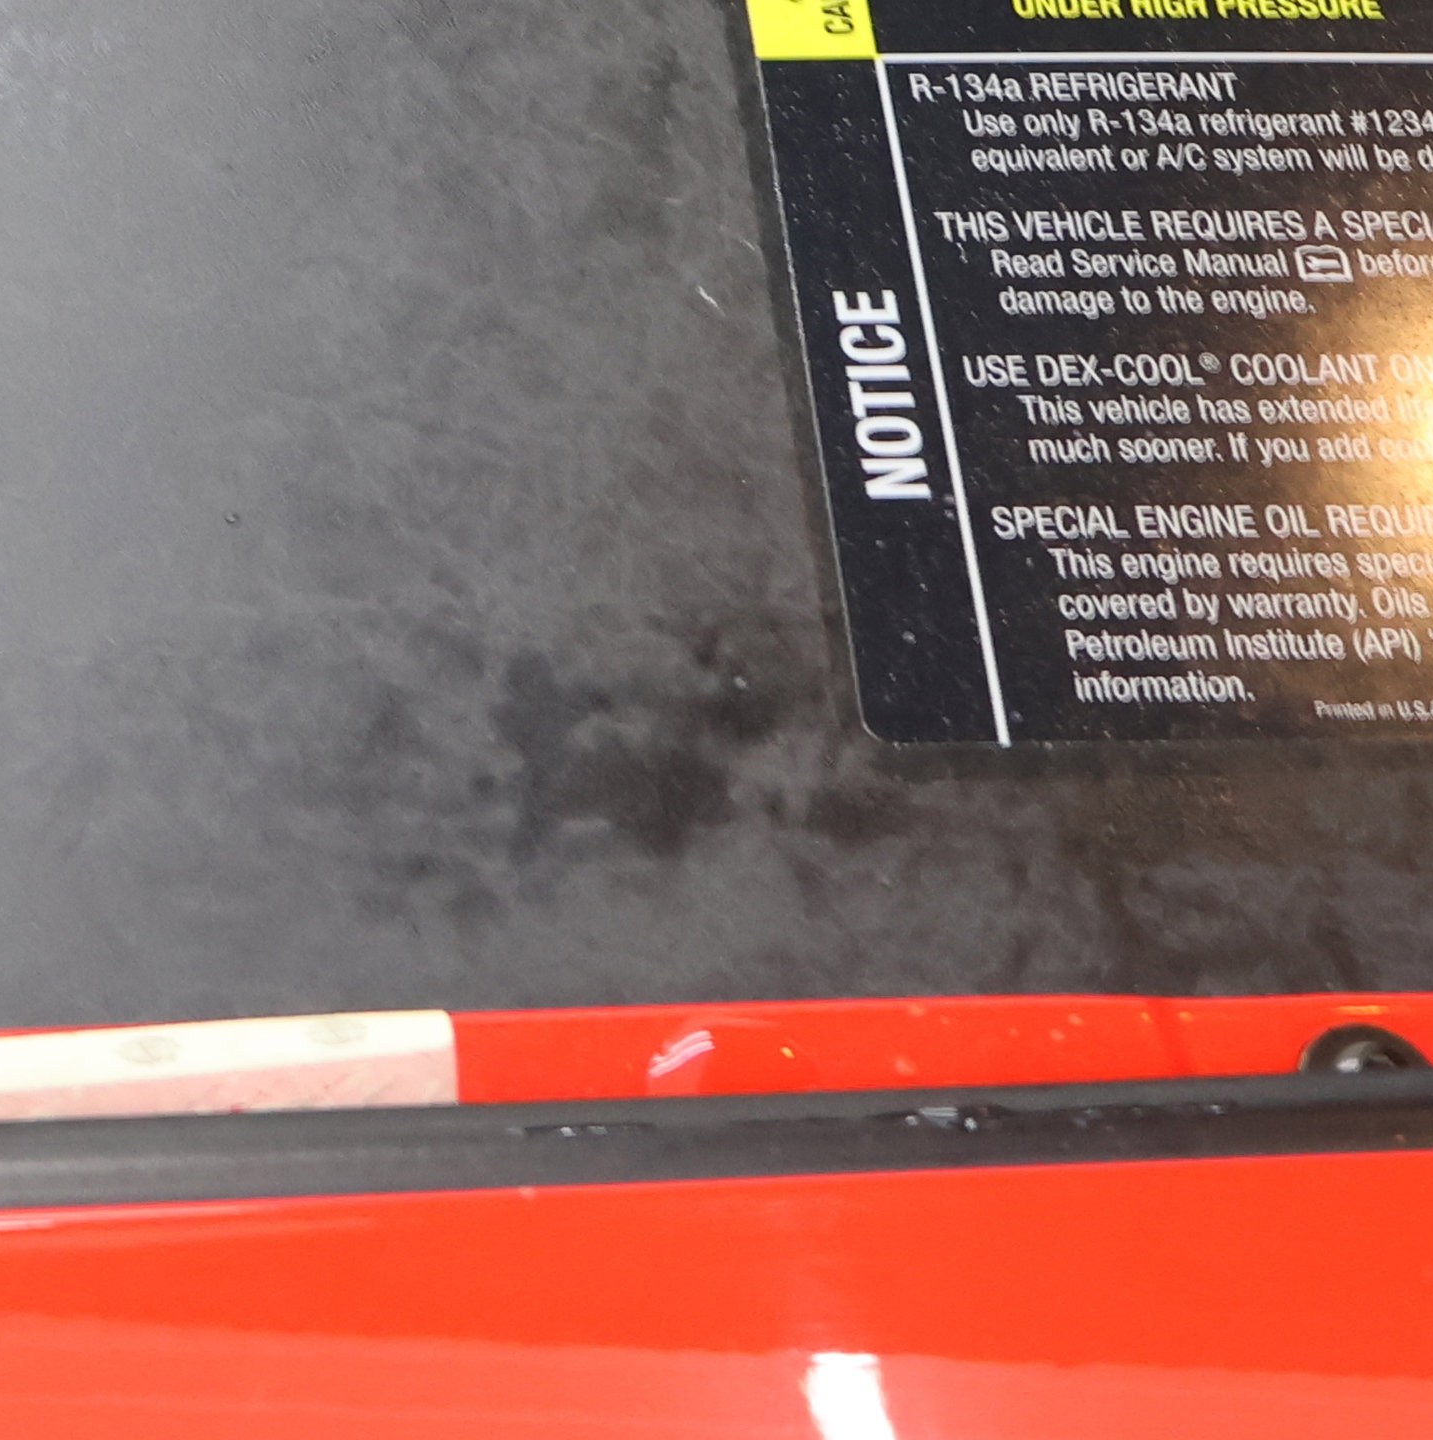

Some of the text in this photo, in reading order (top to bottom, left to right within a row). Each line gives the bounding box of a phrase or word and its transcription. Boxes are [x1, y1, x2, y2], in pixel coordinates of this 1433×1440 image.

[908, 71, 1237, 102] R-134a REFRIGERANT
[962, 108, 1017, 137] Use
[1022, 108, 1080, 141] only
[1086, 107, 1194, 136] R-134a
[1198, 107, 1346, 140] refrigerant
[970, 143, 1116, 176] equivalent
[1120, 147, 1149, 170] or
[1156, 142, 1207, 170] A/C
[1212, 143, 1314, 176] system
[1317, 142, 1369, 171] will
[1372, 143, 1412, 173] be
[932, 210, 1009, 242] THIS
[1011, 209, 1145, 241] VEHICLE
[1149, 209, 1307, 241] REQUIRES
[1313, 209, 1338, 240] A
[998, 284, 1316, 319] damage to the engine.
[961, 354, 1030, 387] USE
[1034, 351, 1220, 386] DEX-COOL®
[1229, 352, 1378, 386] COOLANT
[834, 288, 932, 503] NOTICE
[990, 505, 1131, 539] SPECIAL
[1134, 504, 1260, 539] ENGINE
[1264, 504, 1321, 539] OIL
[1064, 628, 1218, 661] Petroleum
[1222, 627, 1346, 660] Institute
[1352, 627, 1422, 663] (API)
[1072, 669, 1255, 702] information.
